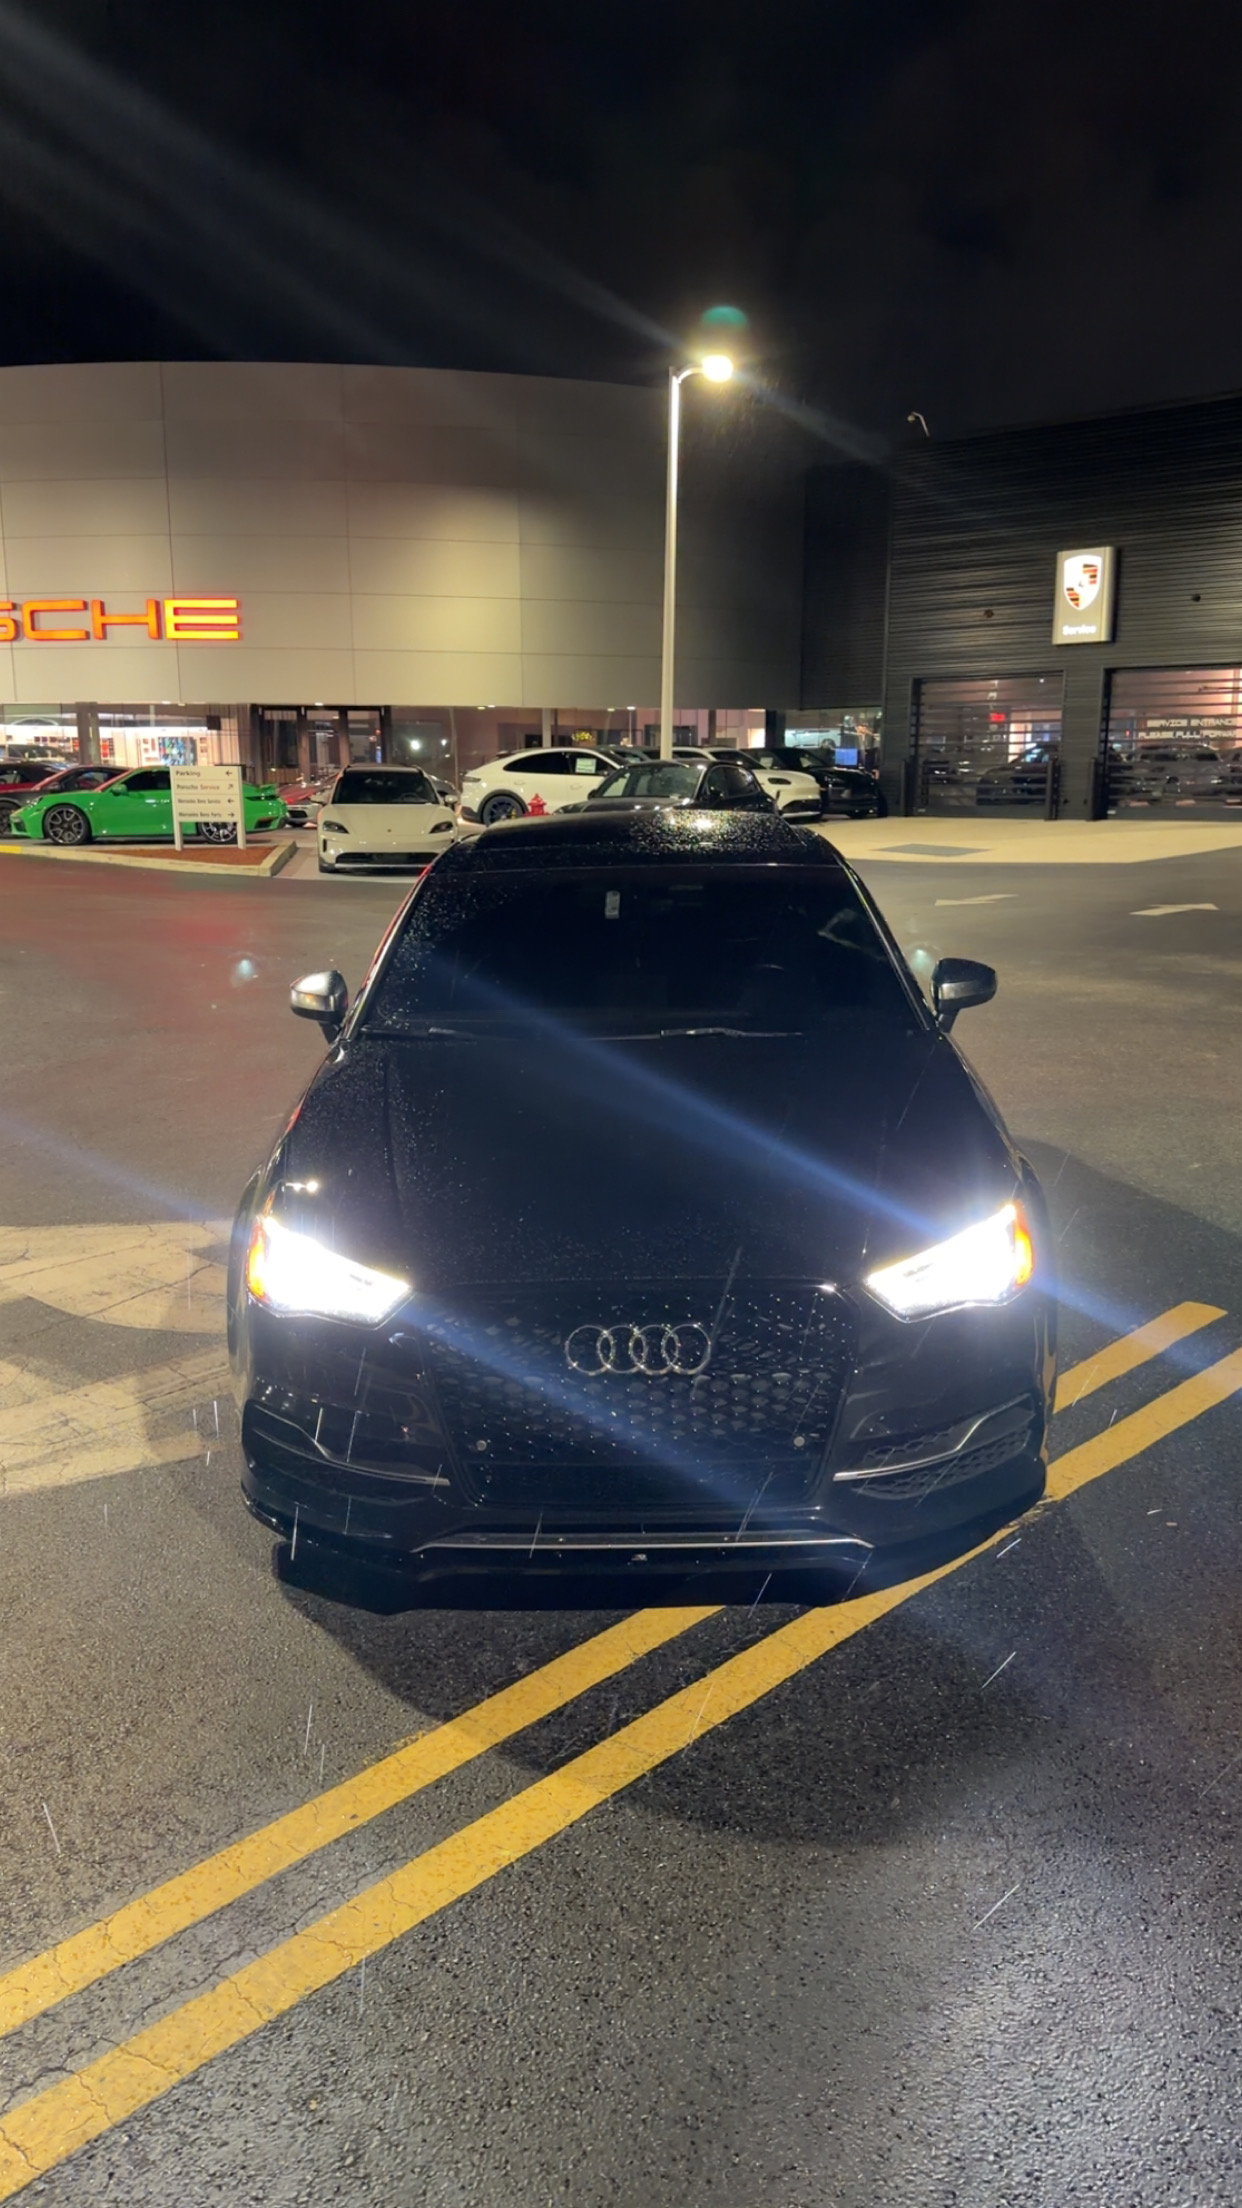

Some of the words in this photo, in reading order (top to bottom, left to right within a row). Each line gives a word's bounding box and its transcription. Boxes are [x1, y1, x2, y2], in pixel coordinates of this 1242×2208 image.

[0, 598, 240, 641] CHE
[1147, 718, 1188, 728] SERVICE
[1175, 730, 1201, 739] PULL
